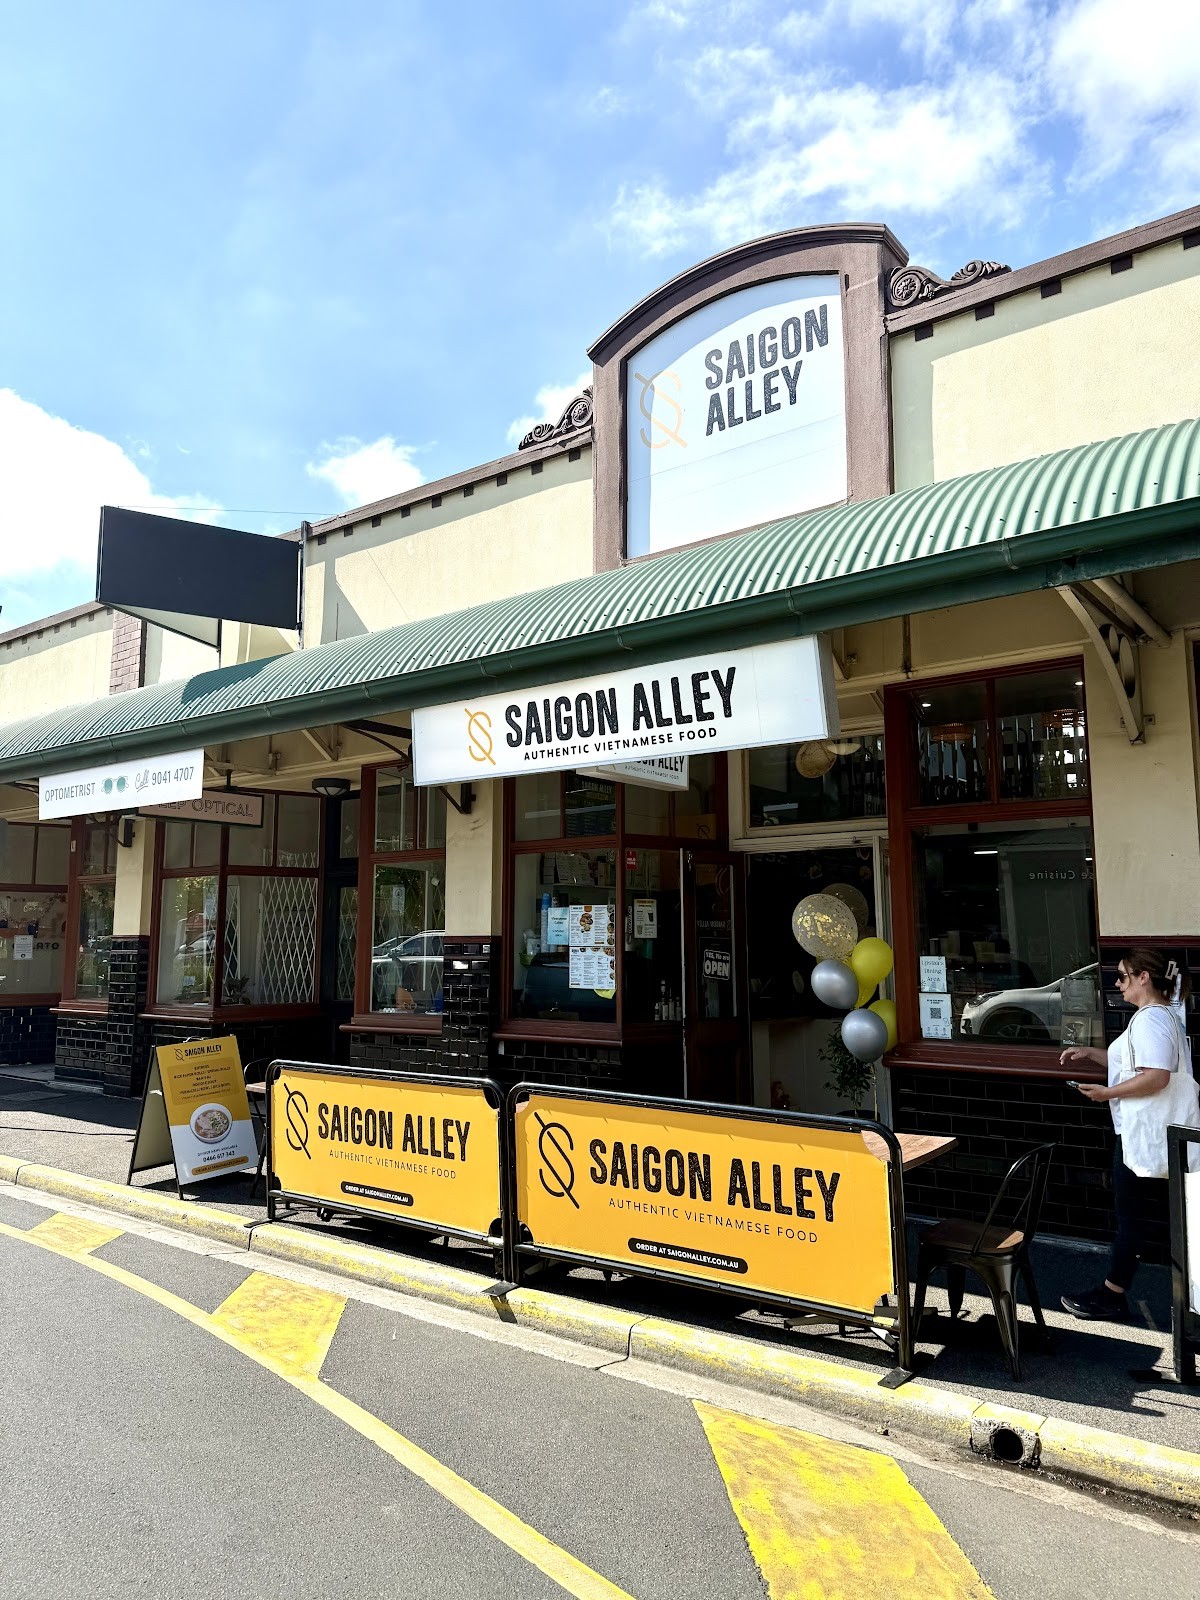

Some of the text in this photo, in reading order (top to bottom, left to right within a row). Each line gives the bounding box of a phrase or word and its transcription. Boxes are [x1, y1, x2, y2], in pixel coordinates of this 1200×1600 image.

[704, 303, 829, 390] SAIGON
[705, 360, 803, 436] ALLEY
[505, 666, 737, 748] SAIGON ALLEY
[523, 727, 717, 761] AUTHENTIC VIETNAMESE FOOD
[658, 755, 685, 772] ALLEY
[45, 782, 96, 802] OPTOMETRIST
[151, 770, 172, 786] 9041
[173, 766, 195, 783] 4707
[191, 798, 254, 818] OPTICAL
[704, 959, 730, 977] OPEN
[184, 1046, 205, 1057] SAIGON
[206, 1044, 222, 1053] ALLEY
[318, 1102, 471, 1162] SAIGON ALLEY
[328, 1149, 457, 1180] AUTHENTIC VIETNAMESE FOOD
[589, 1138, 841, 1223] SAIGON ALLEY
[608, 1197, 819, 1244] AUTHENTIC VIETNAMESE FOOD
[635, 1242, 739, 1269] ORDER AT SAIGONALLEY.COM.AU
